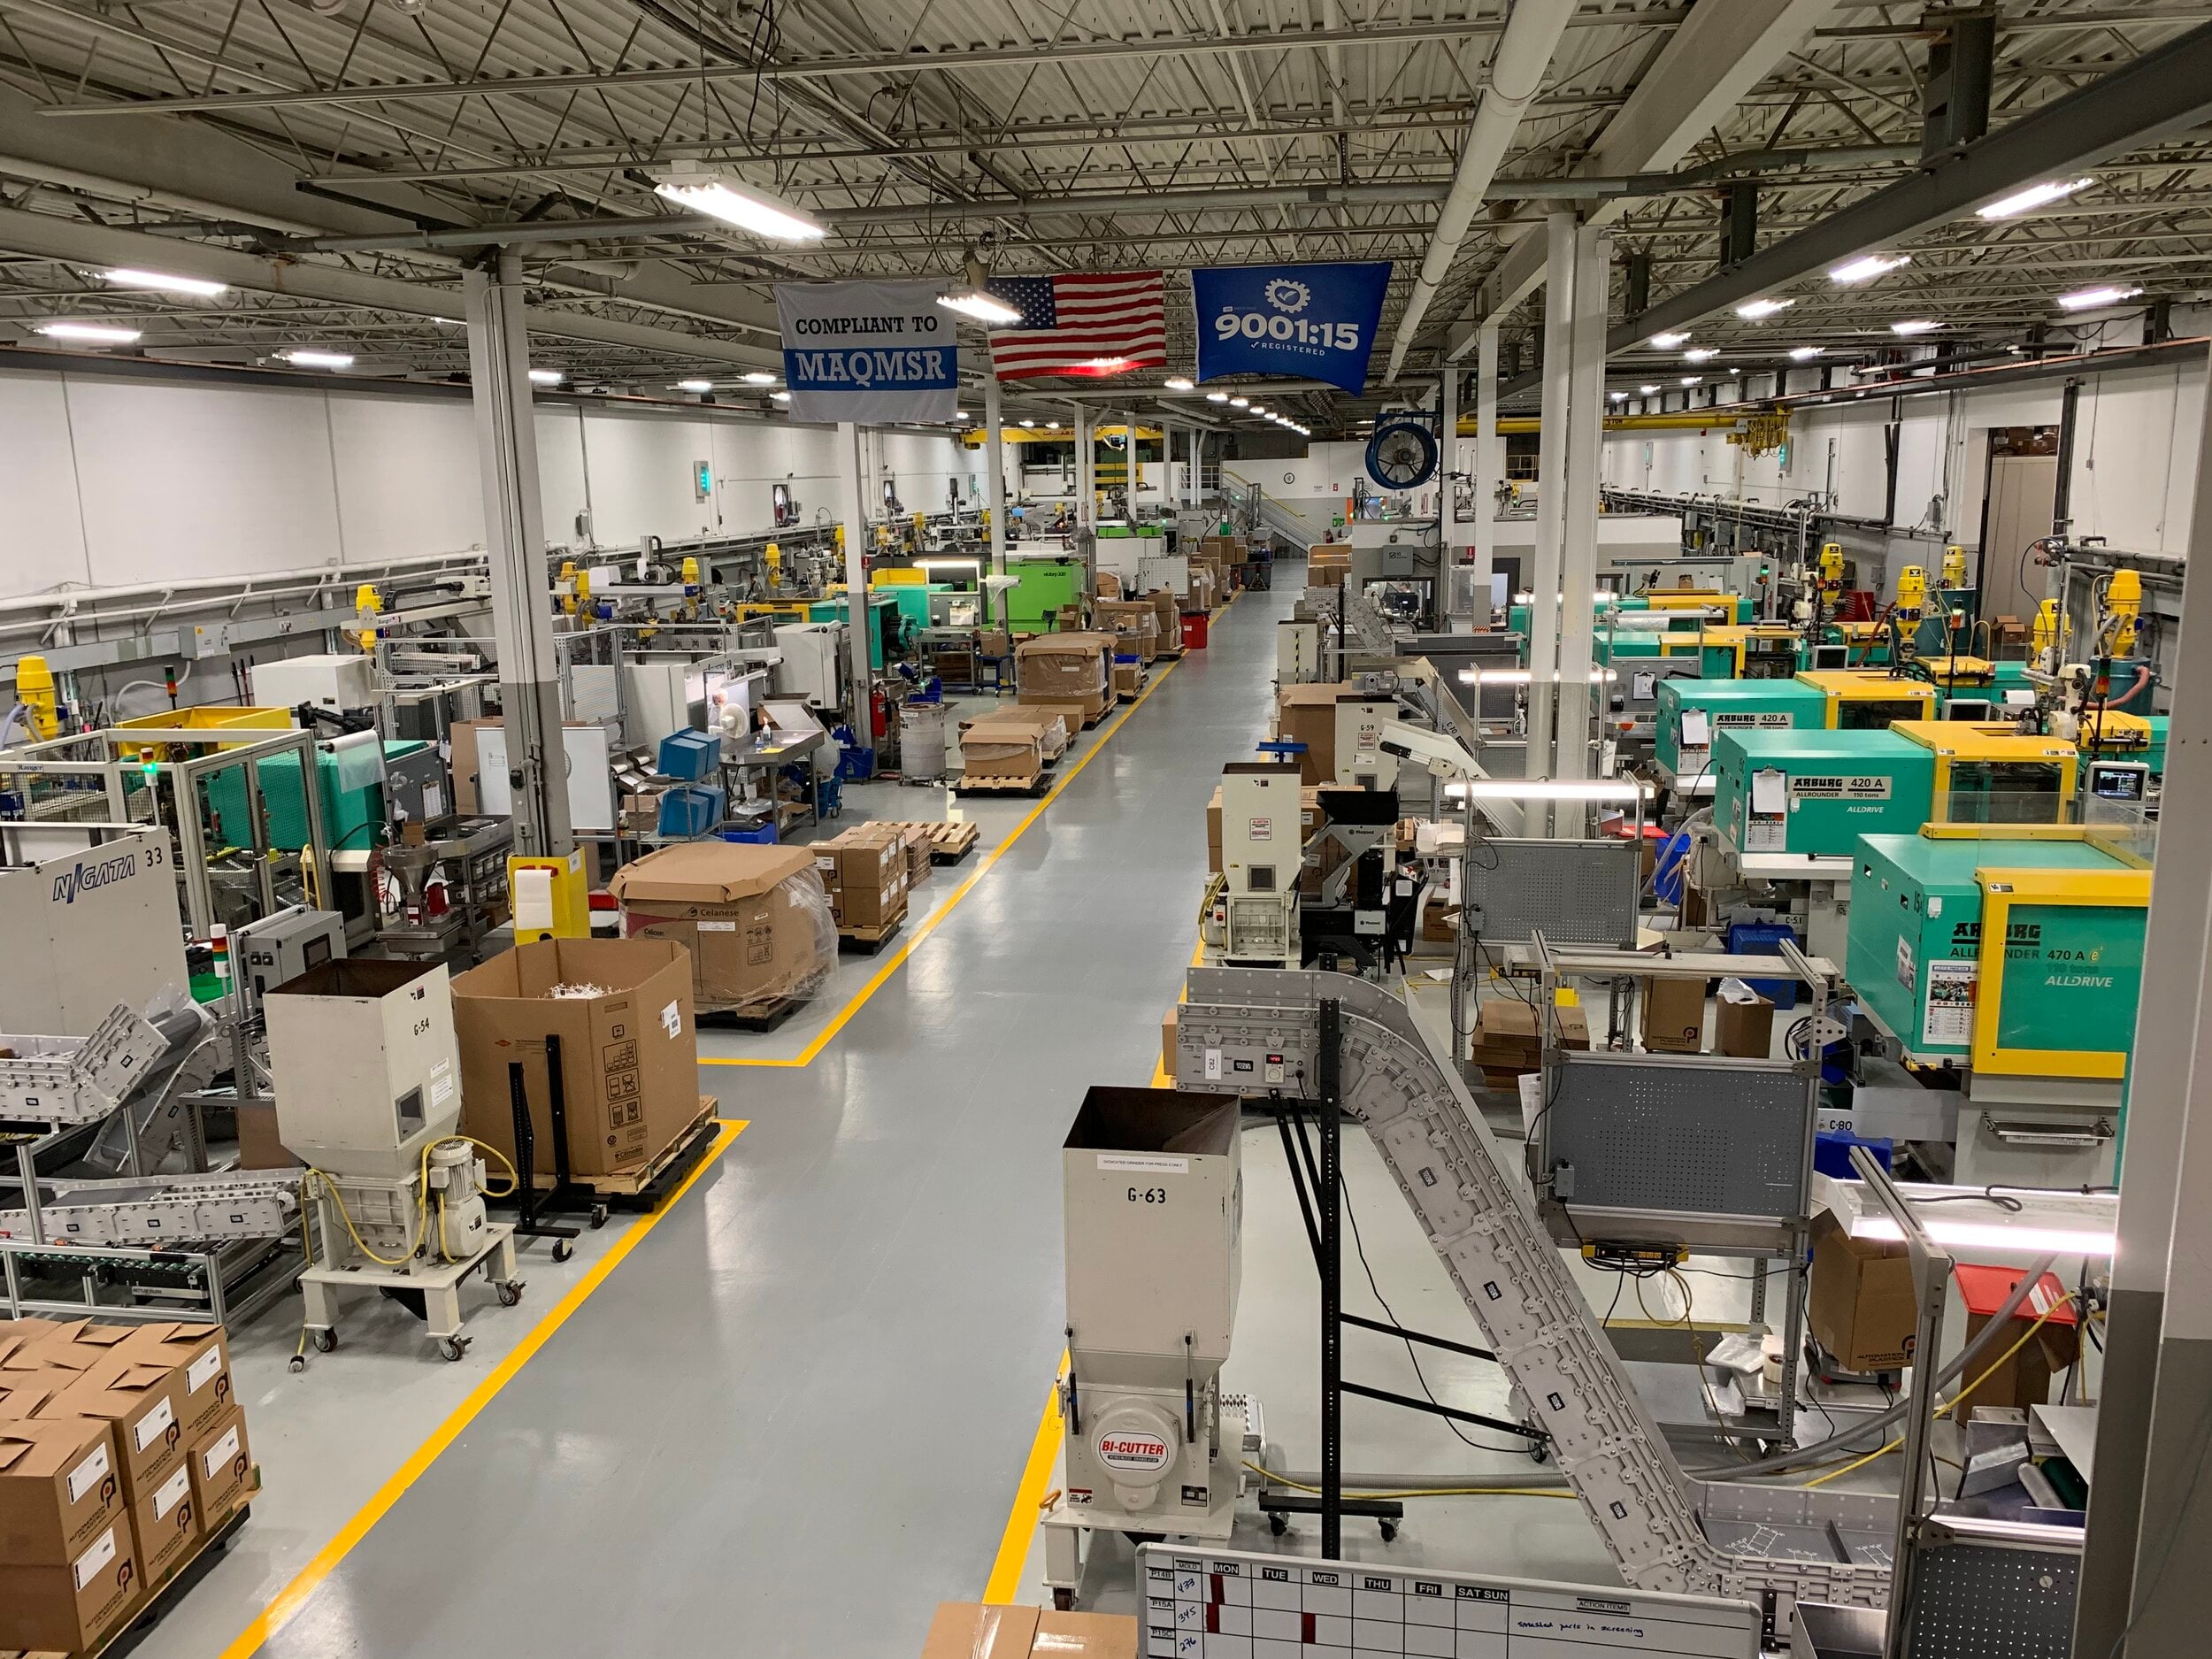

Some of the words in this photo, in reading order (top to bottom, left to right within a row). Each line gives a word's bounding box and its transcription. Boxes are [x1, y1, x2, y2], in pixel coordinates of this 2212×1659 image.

[795, 317, 904, 334] COMPLIANT
[912, 315, 938, 332] TO
[1215, 312, 1359, 350] 9001:15
[1261, 342, 1325, 357] REGISTERED
[795, 350, 946, 388] MAQMSR
[1793, 778, 1842, 787] ARBURG
[1850, 779, 1871, 787] 420
[1874, 779, 1883, 787] A
[145, 847, 163, 867] 33
[700, 908, 740, 917] Celanese
[2047, 949, 2071, 960] 470
[2075, 951, 2085, 960] A
[2045, 975, 2114, 987] ALLDRIVE
[413, 1018, 430, 1036] G-54
[1830, 1119, 1852, 1130] C-80
[1128, 1187, 1166, 1203] G-63
[1102, 1440, 1164, 1455] BI-CUTTER
[1178, 1578, 1195, 1593] 433
[1214, 1563, 1238, 1574] MON
[1264, 1570, 1286, 1580] TUE
[1313, 1574, 1337, 1584] WED
[1366, 1578, 1389, 1590] THU
[1419, 1584, 1438, 1594] FRI
[1458, 1587, 1480, 1598] SAT
[1484, 1590, 1508, 1601] SUN
[1152, 1600, 1172, 1609] P15A
[1578, 1601, 1604, 1609] ACTION
[1178, 1606, 1196, 1623] 345
[1601, 1625, 1643, 1637] screening
[1179, 1637, 1196, 1652] 276
